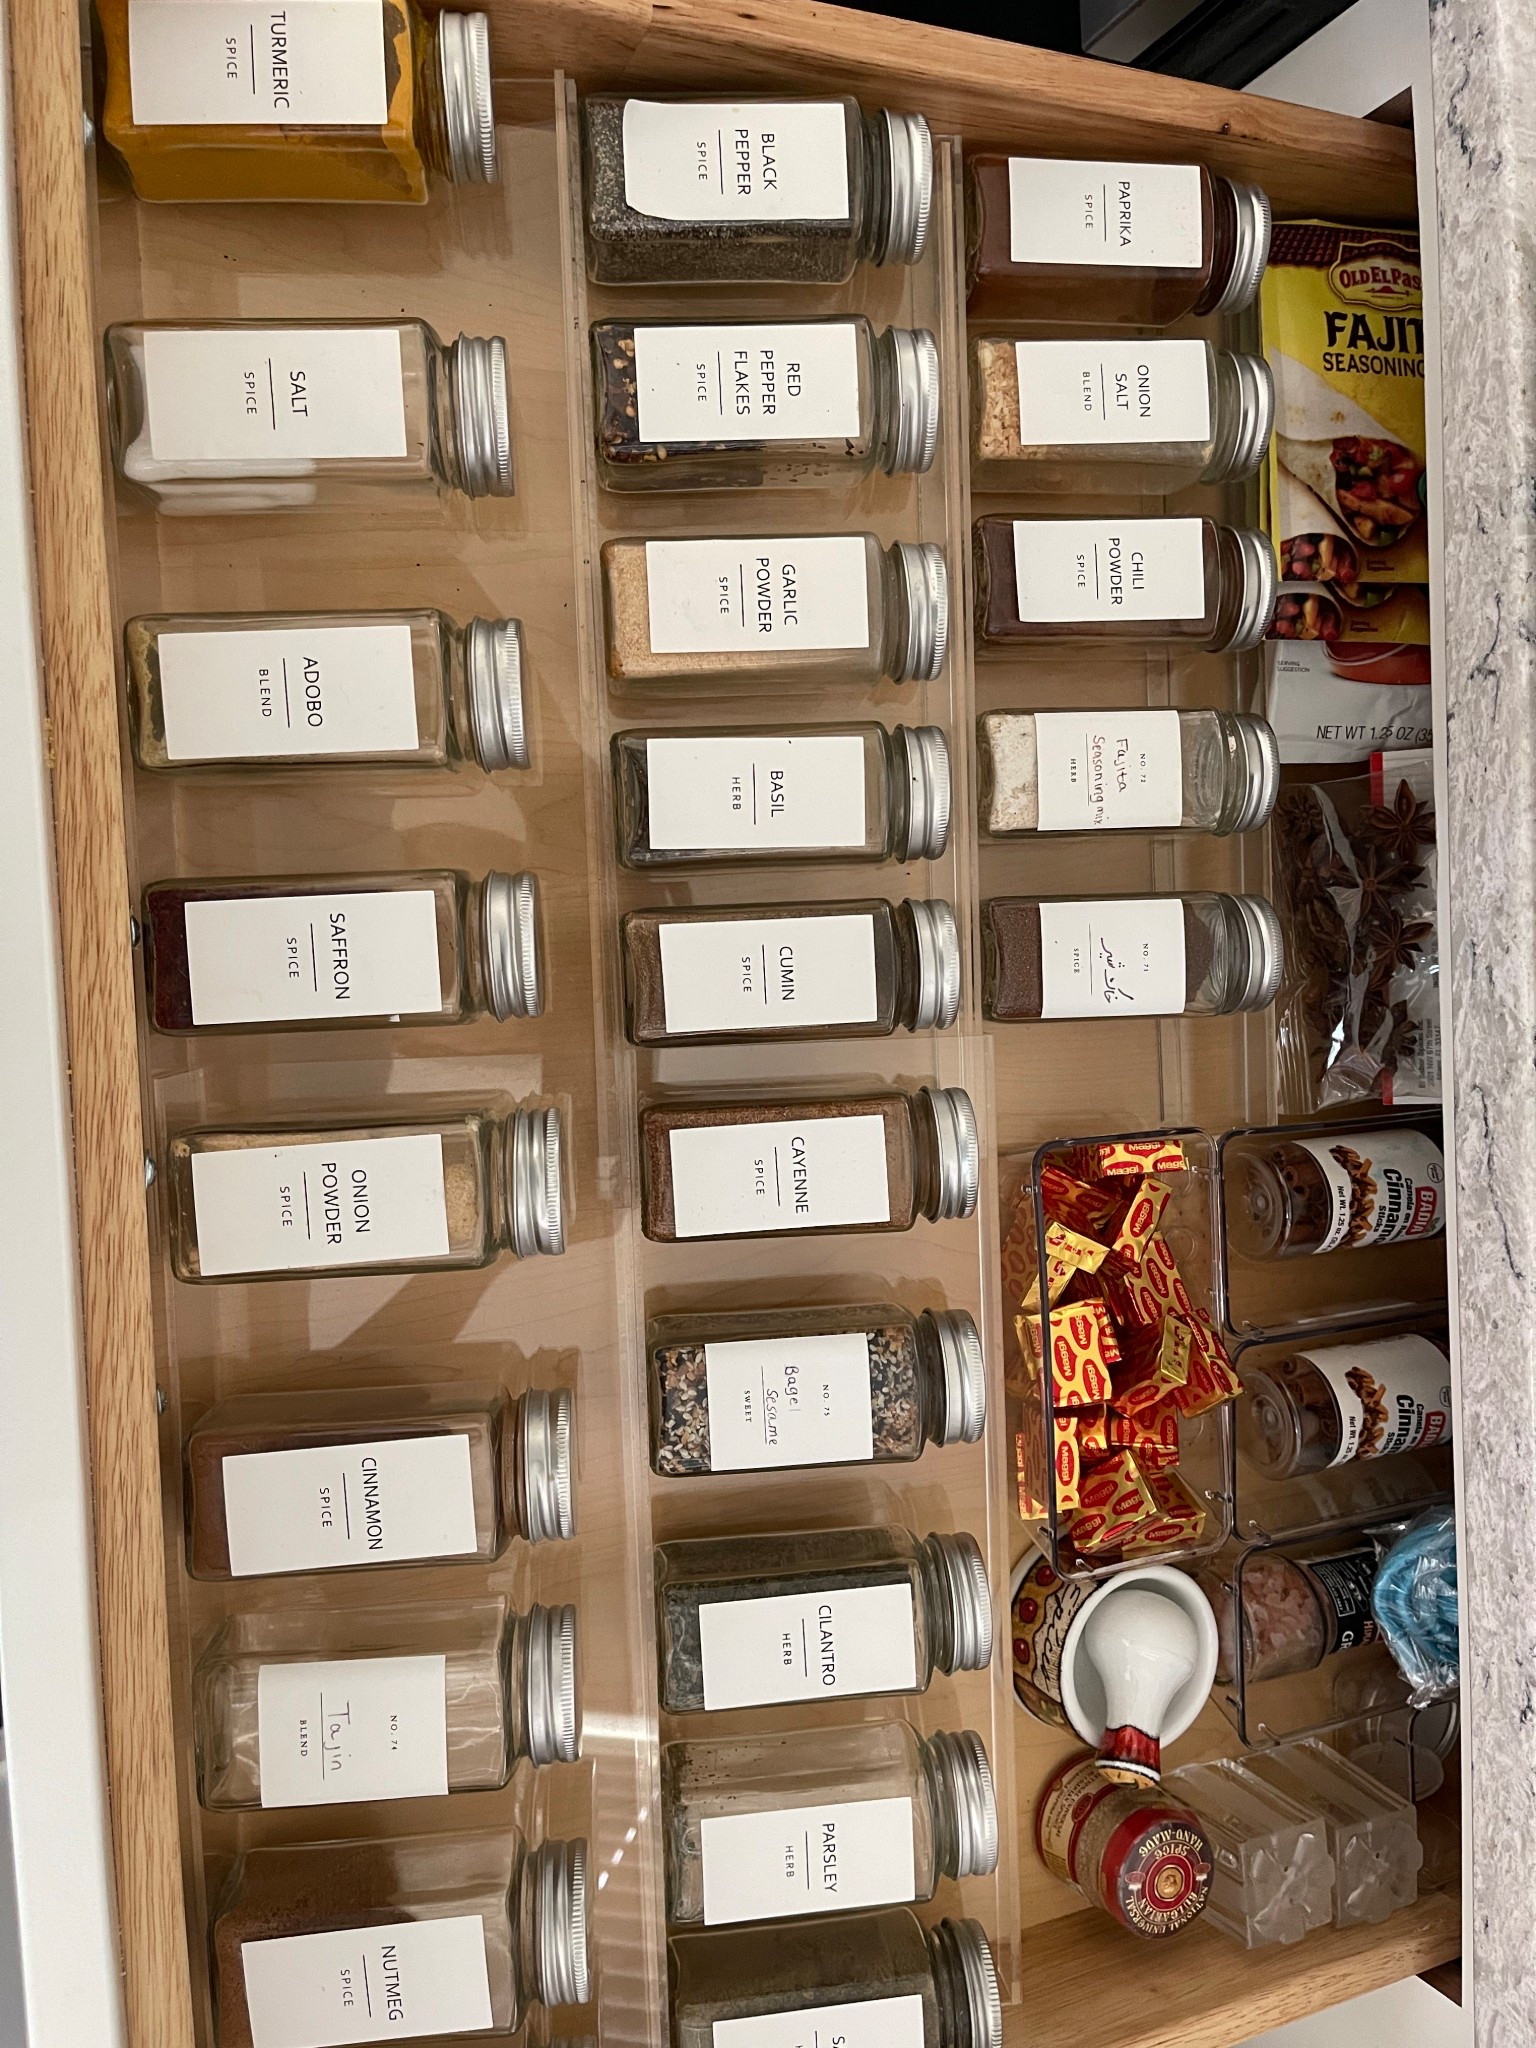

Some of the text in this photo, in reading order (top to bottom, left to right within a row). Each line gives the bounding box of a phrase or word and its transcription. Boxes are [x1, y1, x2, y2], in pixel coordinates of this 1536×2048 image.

[225, 37, 238, 79] SPICE
[270, 9, 290, 109] TURMERIC
[696, 141, 708, 181] SPICE
[734, 128, 752, 196] PEPPER
[760, 133, 778, 191] BLACK
[1084, 194, 1094, 229] SPICE
[1117, 181, 1132, 247] PAPRIKA
[243, 371, 258, 415] SPICE
[289, 370, 309, 418] SALT
[696, 363, 708, 402] SPICE
[733, 350, 751, 416] FLAKES
[759, 349, 777, 416] PEPPER
[786, 362, 802, 397] RED
[1082, 371, 1093, 412] BLEND
[1114, 373, 1129, 411] SALT
[1136, 364, 1152, 418] ONION
[1076, 554, 1086, 589] SPICE
[1107, 537, 1123, 606] POWDER
[1130, 551, 1145, 590] CHILI
[718, 576, 730, 615] SPICE
[755, 557, 773, 634] POWDER
[781, 563, 799, 626] GARLIC
[258, 668, 273, 718] BLEND
[302, 656, 324, 728] ADOBO
[1316, 726, 1342, 740] NET
[1346, 726, 1366, 740] WT
[1370, 726, 1394, 740] 1.25
[1396, 726, 1415, 740] OZ
[1089, 735, 1108, 804] Seasoning
[1140, 774, 1146, 783] 72
[731, 776, 742, 811] HERB
[770, 770, 785, 818] BASIL
[286, 937, 300, 979] SPICE
[329, 912, 351, 1000] SAFFRON
[741, 956, 753, 993] SPICE
[779, 945, 796, 1001] CUMIN
[1143, 964, 1149, 972] 71
[753, 1159, 766, 1196] SPICE
[791, 1136, 810, 1214] CAYENNE
[1106, 1166, 1139, 1176] Maggi
[1157, 1162, 1184, 1170] Magg
[279, 1185, 293, 1227] SPICE
[320, 1162, 343, 1245] POWDER
[350, 1169, 371, 1233] ONION
[1336, 1186, 1346, 1198] Net
[1373, 1168, 1404, 1244] Cinnamo
[1410, 1190, 1434, 1233] BADIA
[1132, 1202, 1152, 1234] Maggi
[1337, 1212, 1346, 1227] 1.25
[1372, 1204, 1386, 1233] Sticks
[1149, 1262, 1168, 1294] Maggi
[1074, 1315, 1088, 1346] Magg
[1056, 1340, 1073, 1377] Maggi
[784, 1366, 802, 1412] Bagel
[822, 1384, 830, 1417] NO. 75
[1086, 1364, 1101, 1400] Maggi
[744, 1390, 752, 1423] SWEET
[1348, 1416, 1356, 1428] Net
[1420, 1415, 1443, 1448] BADI
[1061, 1446, 1071, 1482] Maggi
[319, 1487, 333, 1528] SPICE
[361, 1457, 384, 1550] CINNAMON
[1084, 1484, 1115, 1505] Maggi
[1116, 1494, 1142, 1512] Magg
[1072, 1516, 1102, 1538] Maggi
[781, 1632, 793, 1666] HERB
[818, 1604, 836, 1686] CILANTRO
[300, 1720, 308, 1757] BLEND
[323, 1700, 352, 1771] Tajin
[390, 1714, 398, 1736] NO.
[784, 1845, 795, 1878] HERB
[821, 1822, 838, 1893] PARSLEY
[1125, 1886, 1209, 1934] NATIONAL UNIVERSAL
[1138, 1891, 1198, 1922] BULGARIAN
[340, 1969, 354, 2007] SPICE
[380, 1945, 404, 2021] NUTMEG
